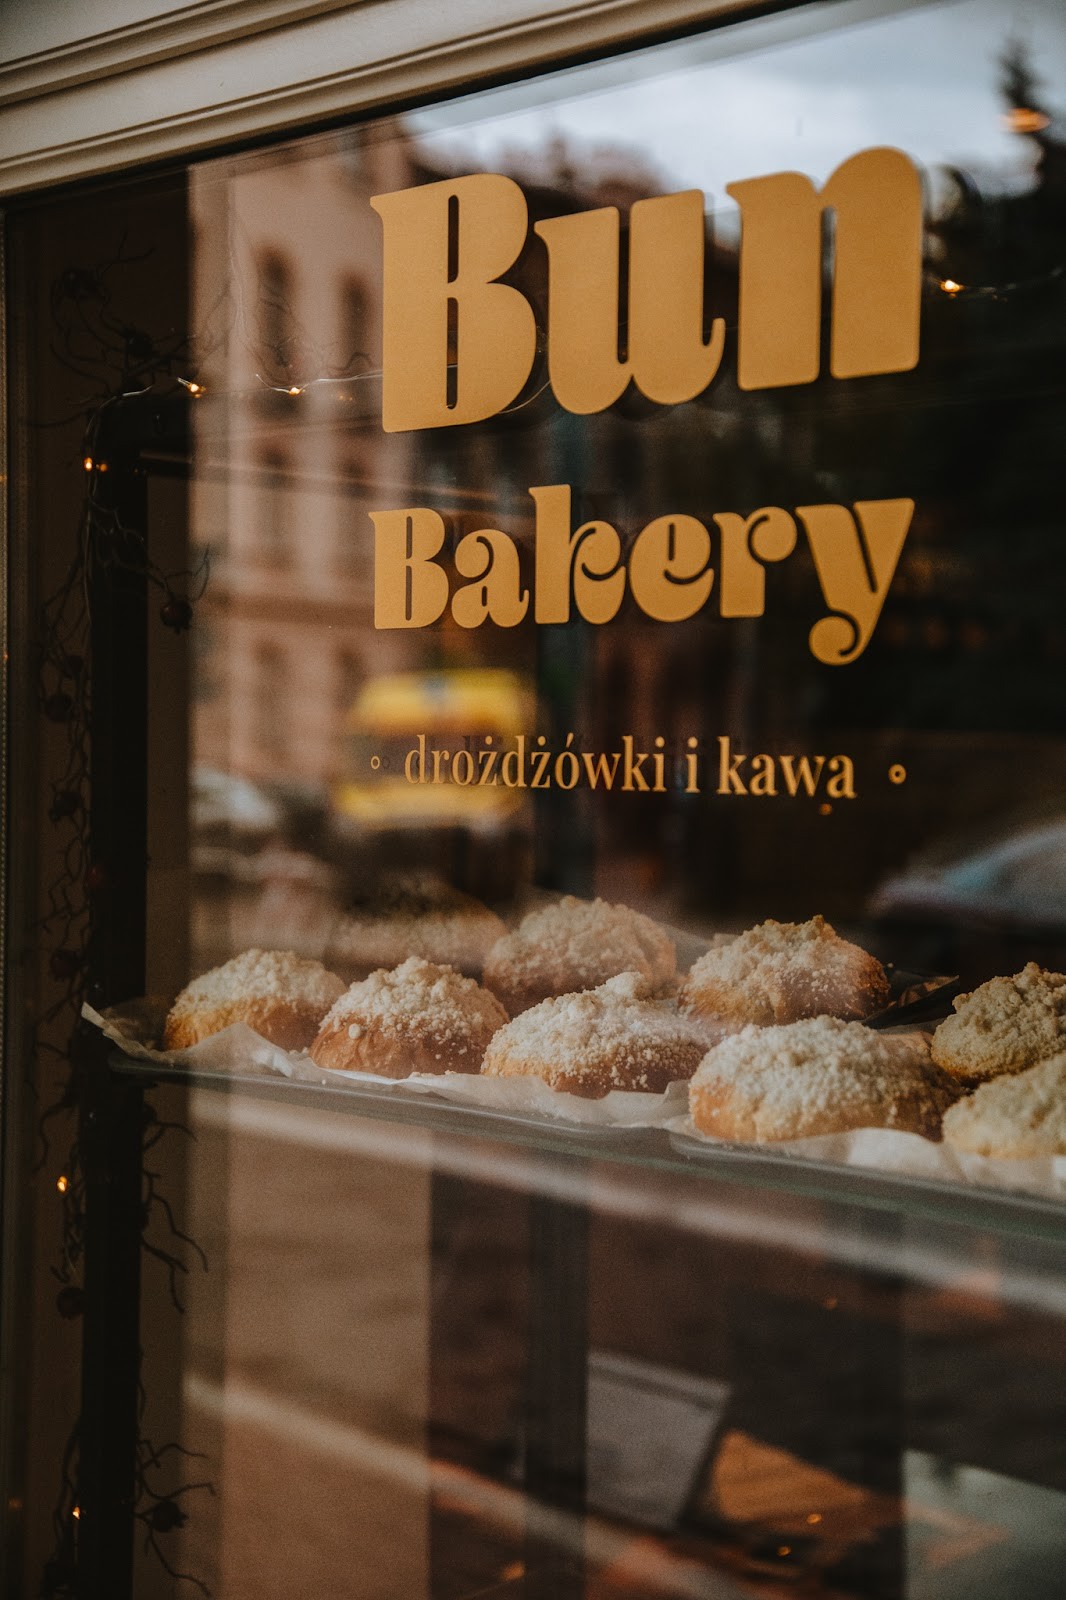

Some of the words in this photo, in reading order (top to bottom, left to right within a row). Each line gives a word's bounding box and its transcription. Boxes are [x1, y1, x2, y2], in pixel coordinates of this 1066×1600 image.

[370, 145, 923, 433] Bun
[368, 483, 915, 667] Bakery
[404, 732, 667, 793] drożdżówki
[685, 736, 701, 794] i
[717, 736, 858, 799] kawa
